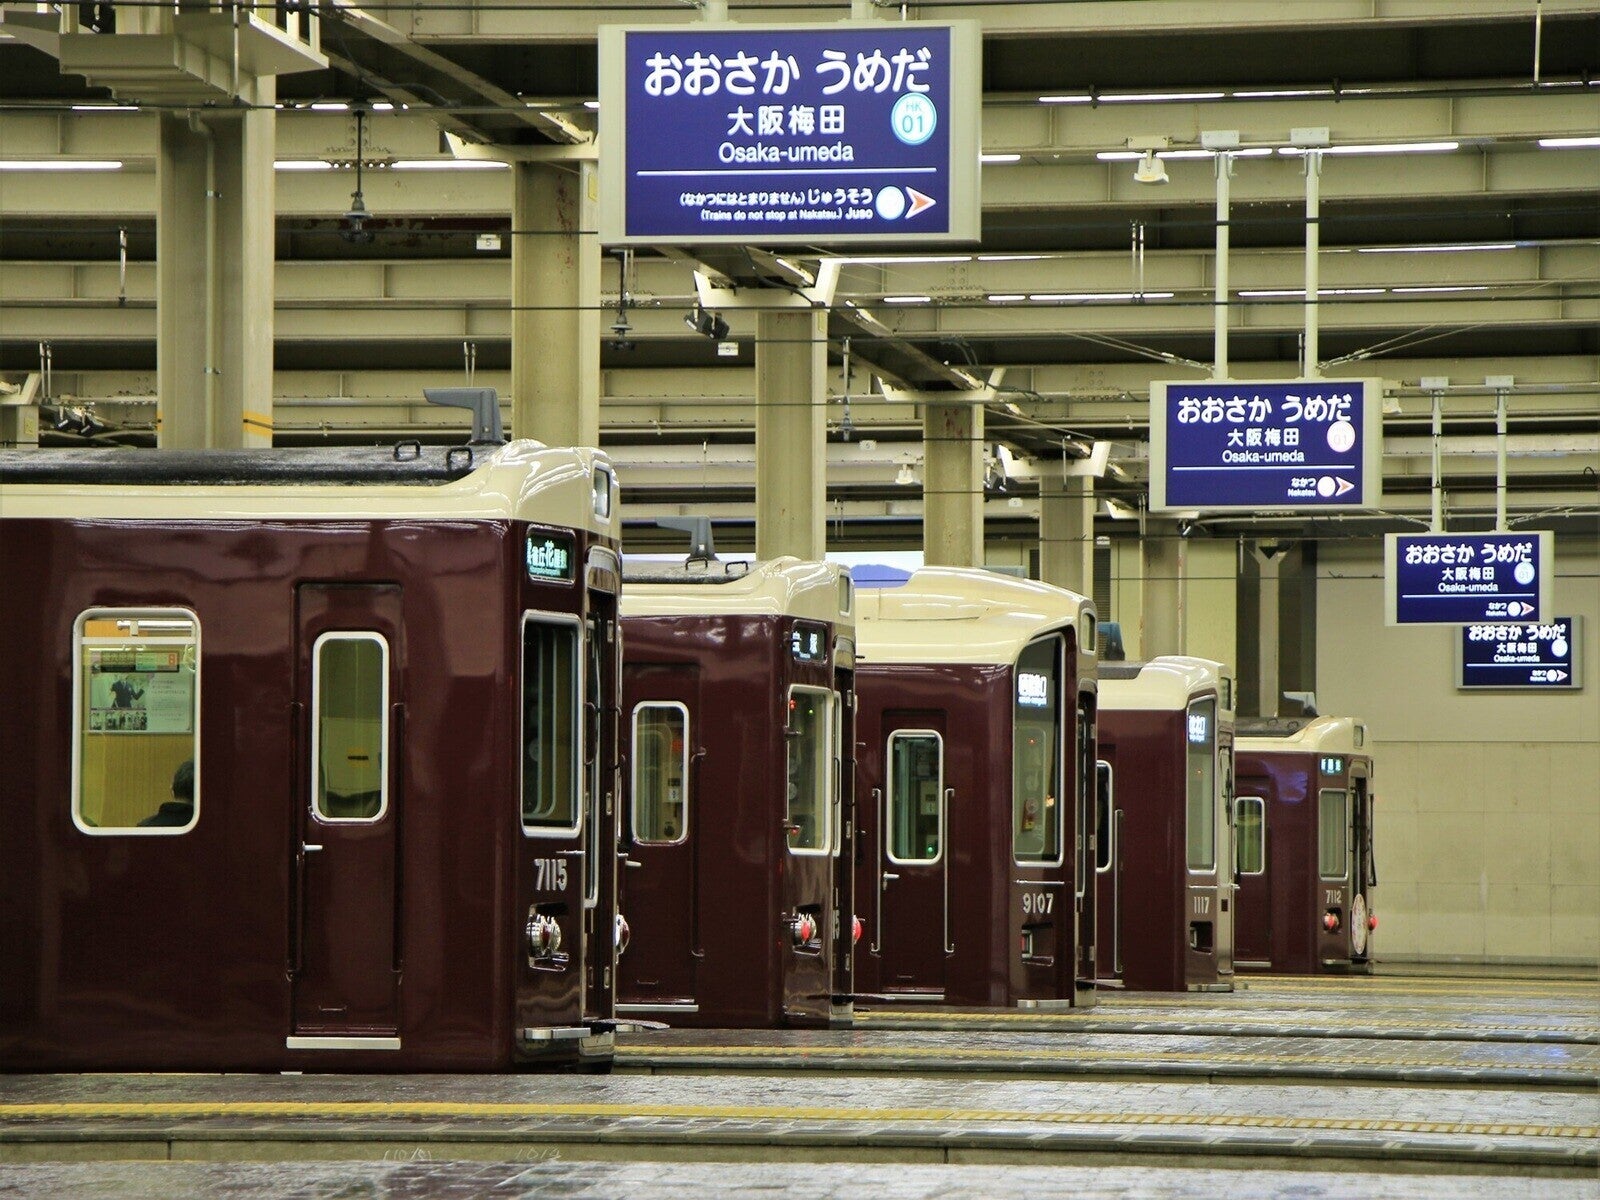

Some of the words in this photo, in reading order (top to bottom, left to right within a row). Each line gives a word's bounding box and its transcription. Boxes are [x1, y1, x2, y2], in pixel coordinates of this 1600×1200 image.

[644, 51, 800, 96] おおさか
[815, 47, 932, 95] うめだ
[727, 104, 845, 136] 大阪梅田
[902, 114, 923, 133] 01
[718, 142, 854, 164] Osaka-umeda
[807, 188, 874, 205] じゅうそう
[733, 209, 747, 220] do
[748, 209, 763, 220] not
[765, 209, 786, 222] stop
[787, 208, 798, 220] at
[1177, 395, 1272, 423] おおさか
[1281, 394, 1353, 422] うめだ
[1227, 428, 1300, 447] 大阪梅田
[1222, 450, 1305, 463] Osaka-umeda
[1405, 543, 1475, 564] おおさか
[1480, 542, 1533, 563] うめだ
[1441, 567, 1495, 581] 大阪梅田
[1438, 582, 1499, 593] Osaka-umeda
[1468, 625, 1522, 641] おおさか
[1526, 624, 1567, 640] うめだ
[1496, 642, 1537, 654] 大阪梅田
[534, 859, 568, 890] 7115
[1023, 893, 1054, 914] 9107
[1193, 896, 1210, 914] 1117
[1325, 890, 1342, 904] 7112
